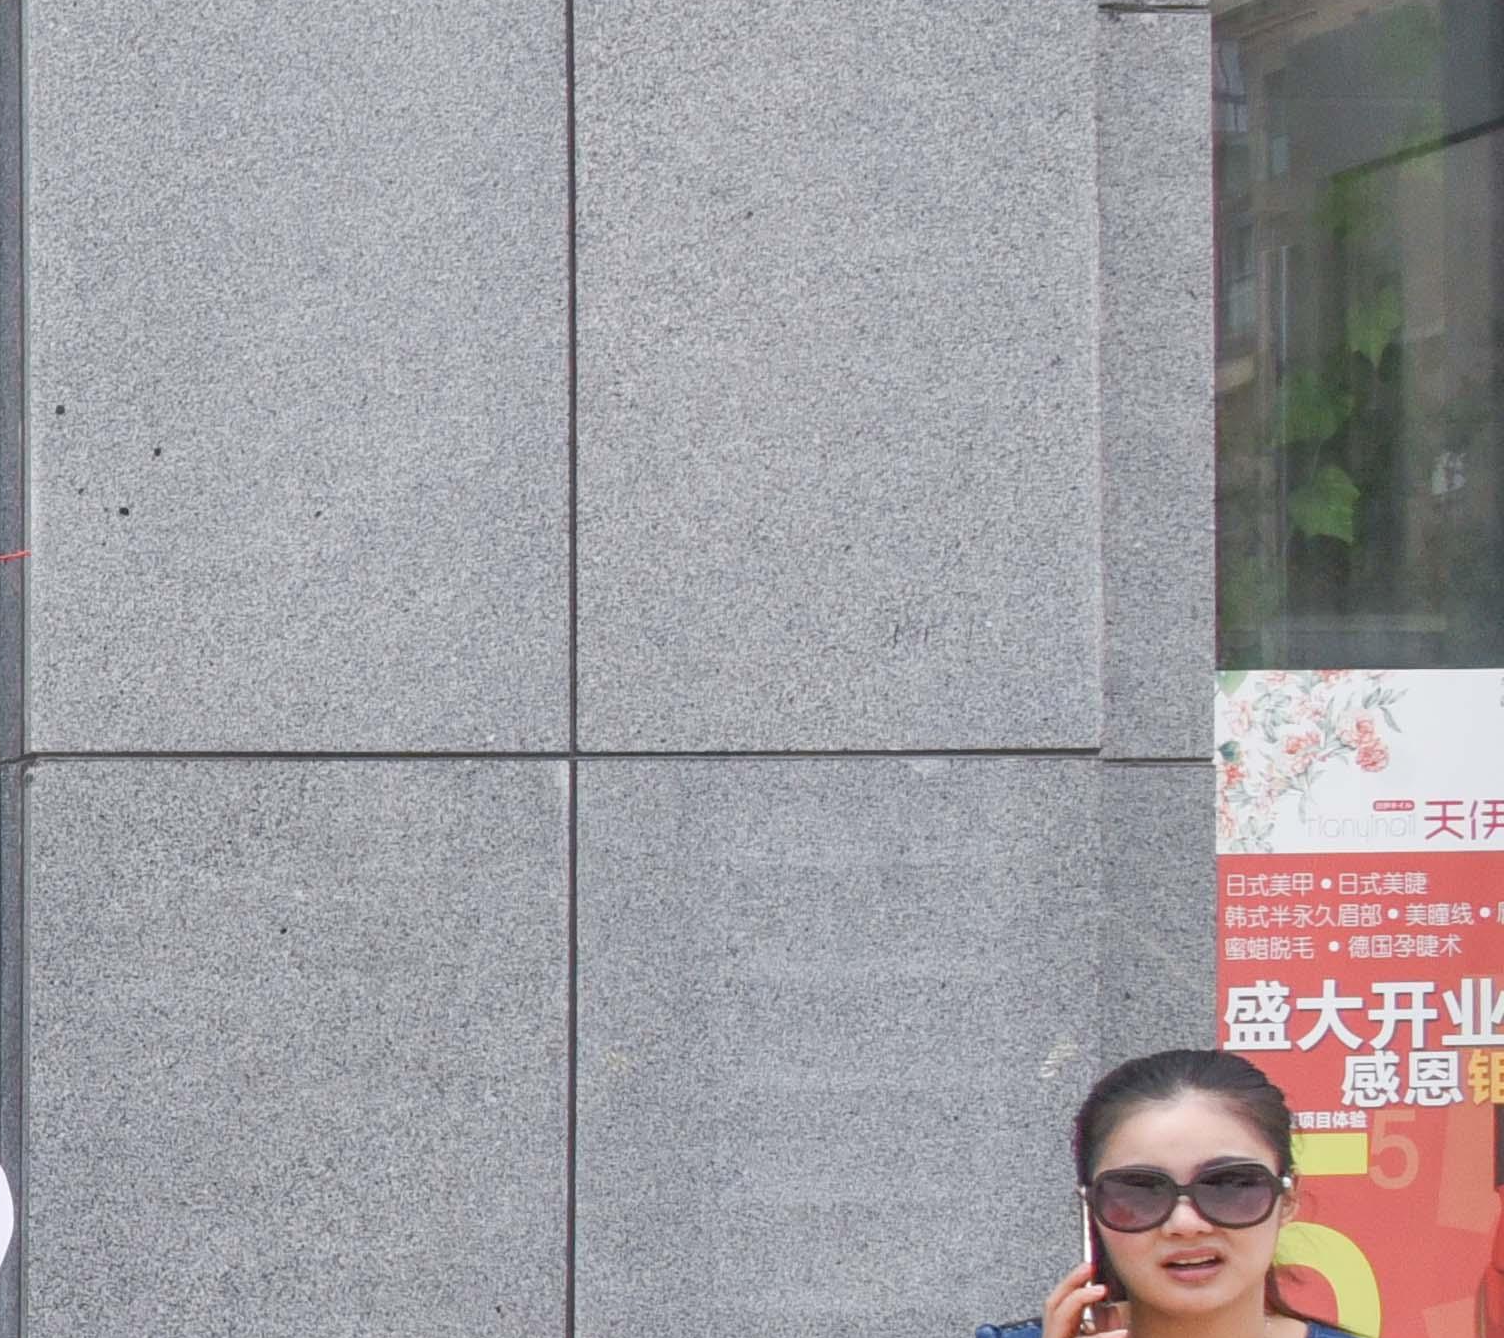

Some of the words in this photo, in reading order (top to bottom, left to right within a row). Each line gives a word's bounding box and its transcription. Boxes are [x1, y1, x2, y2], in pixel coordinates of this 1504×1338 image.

[1226, 873, 1314, 897] 日式美甲
[1338, 871, 1428, 895] 日式美睫
[1224, 904, 1382, 929] 韩式半永久眉部
[1405, 902, 1475, 926] 美瞳线
[1224, 935, 1315, 960] 蜜蜡脱毛
[1223, 978, 1504, 1051] 盛大开业
